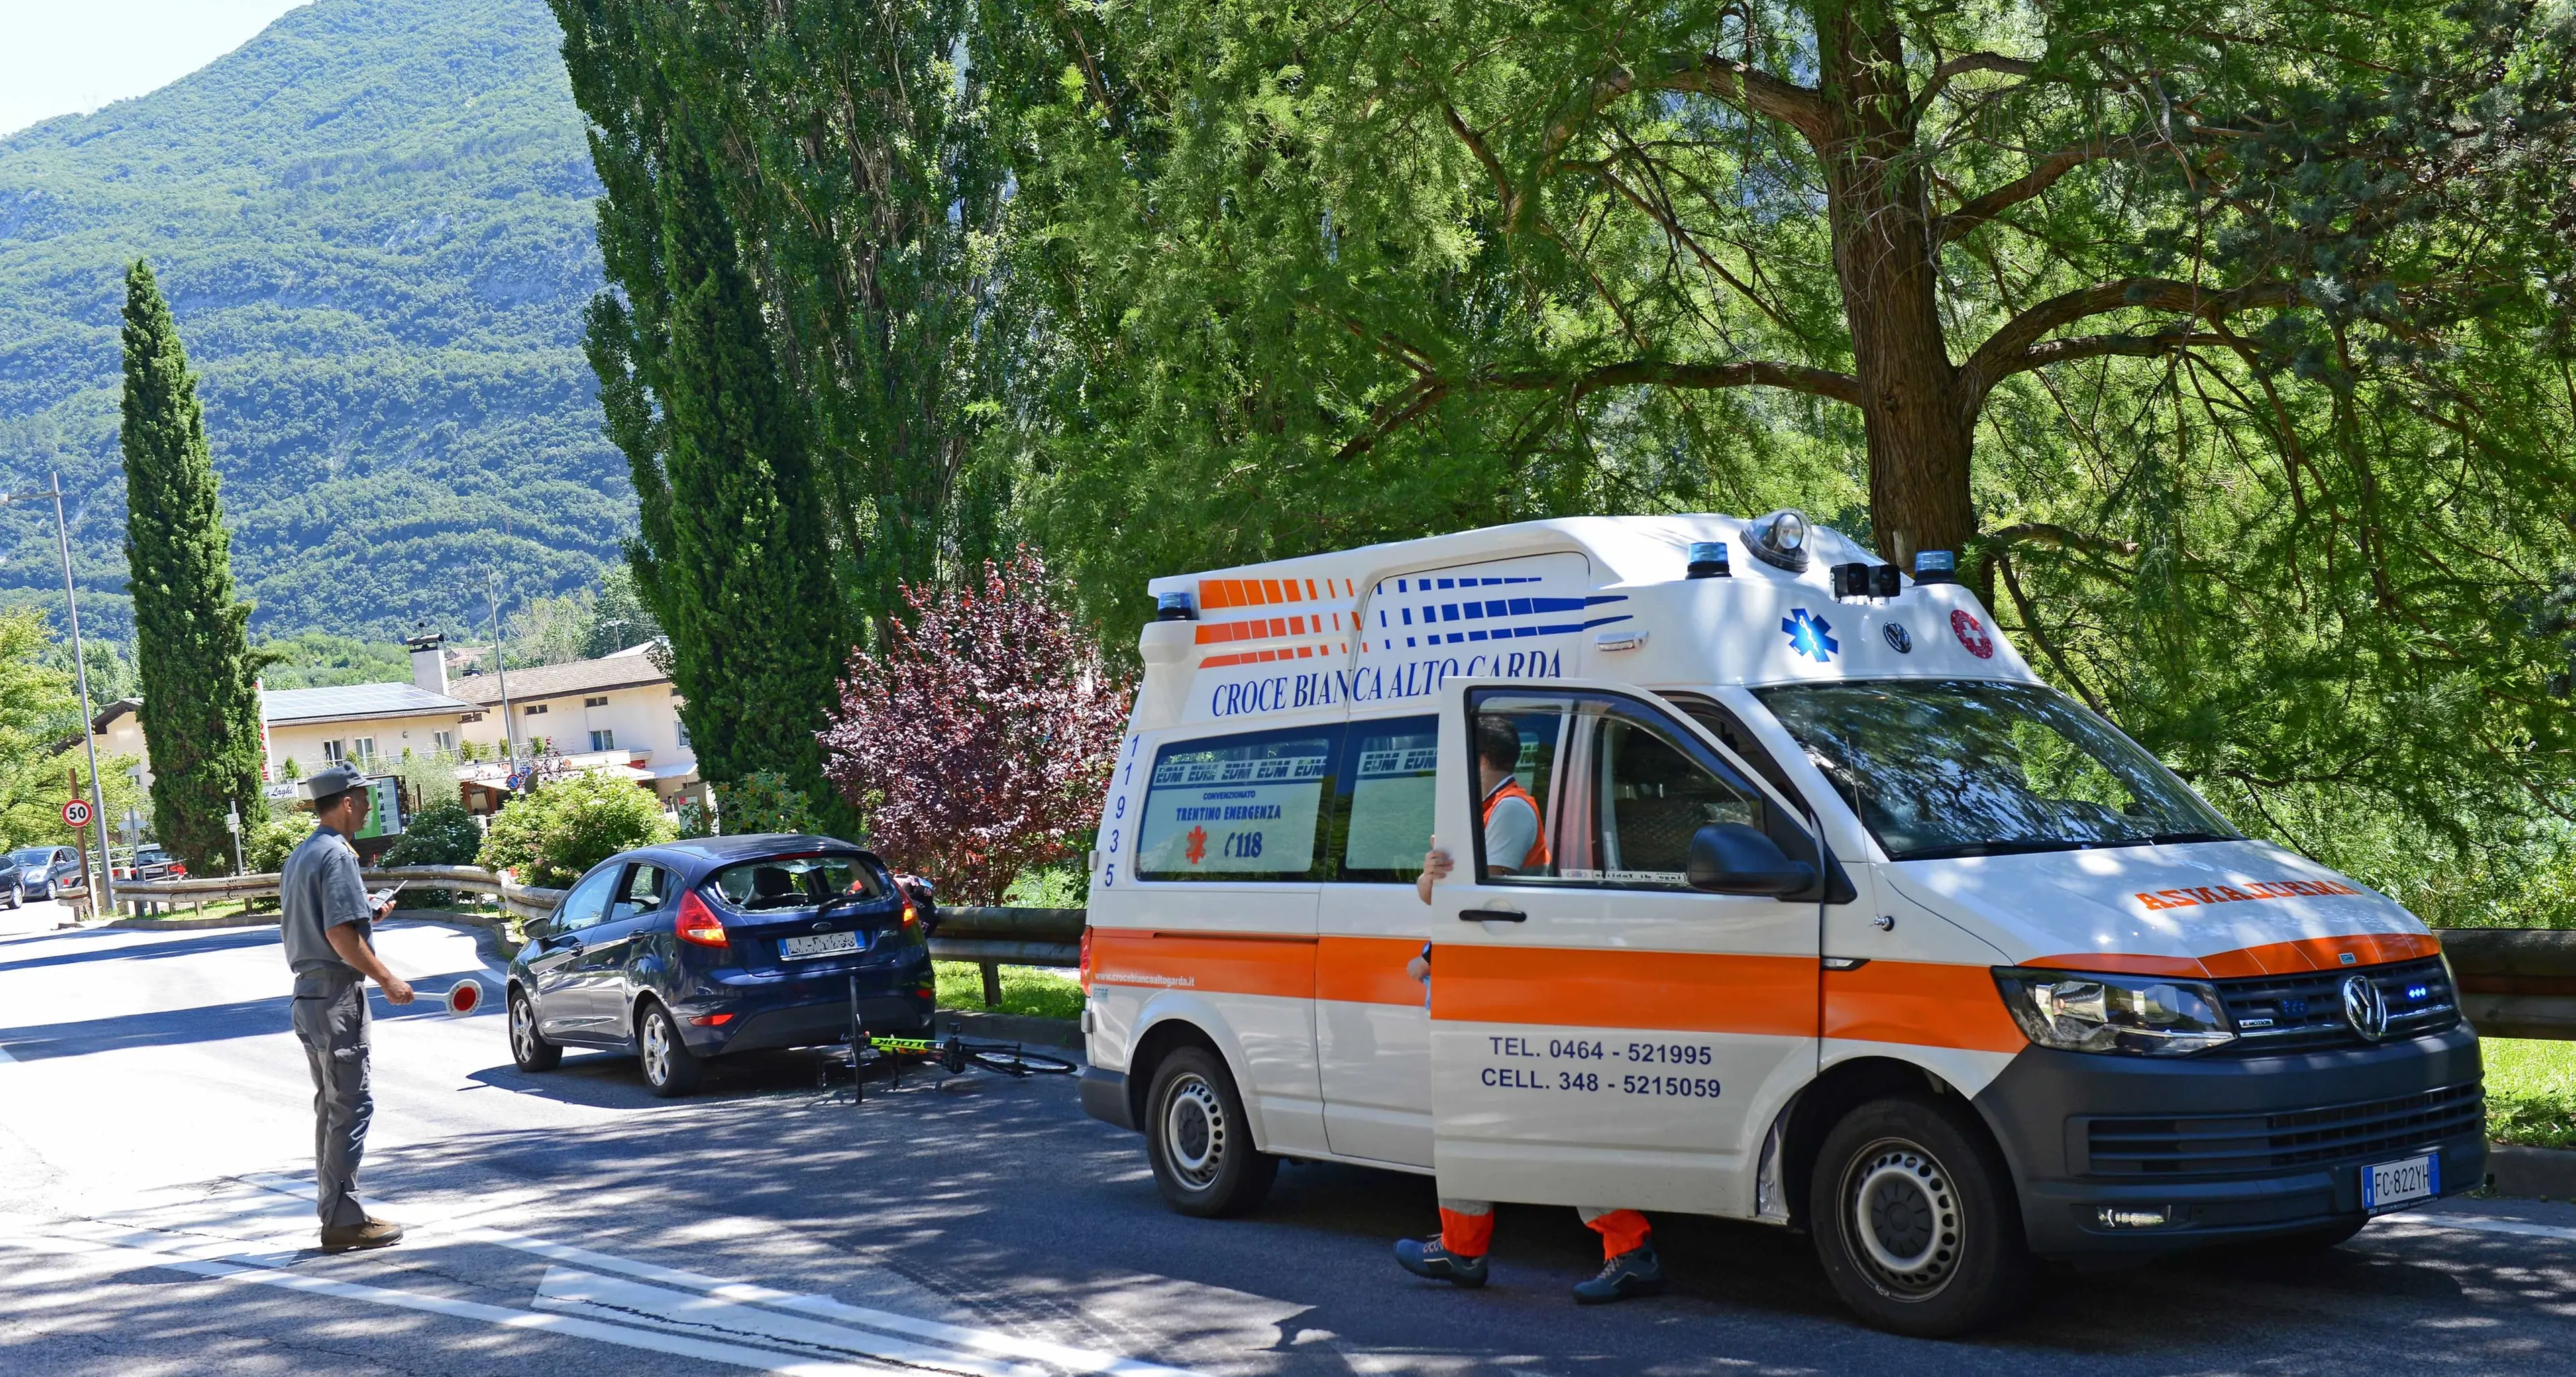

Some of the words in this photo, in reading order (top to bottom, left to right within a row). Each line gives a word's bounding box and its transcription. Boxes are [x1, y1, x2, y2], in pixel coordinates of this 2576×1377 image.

[1212, 677, 1287, 717] CROCE
[1293, 666, 1383, 708] BIANCA
[1387, 658, 1458, 698] ALTO
[271, 785, 292, 797] Laghi
[1203, 790, 1256, 800] CONVENZIONATO
[69, 806, 86, 820] 50
[1176, 806, 1222, 821] TRENTINO
[1224, 805, 1281, 821] EMERGENZA
[1235, 832, 1263, 858] 118
[1095, 973, 1195, 987] www.crocebiancaaltogarda.it
[878, 1039, 922, 1047] LOOK
[1489, 1036, 1541, 1058] TEL.
[1549, 1039, 1604, 1060] 0464
[1627, 1043, 1712, 1065] 521995
[1481, 1068, 1550, 1090] CELL.
[1558, 1071, 1599, 1092] 348
[1623, 1075, 1721, 1098] 5215059
